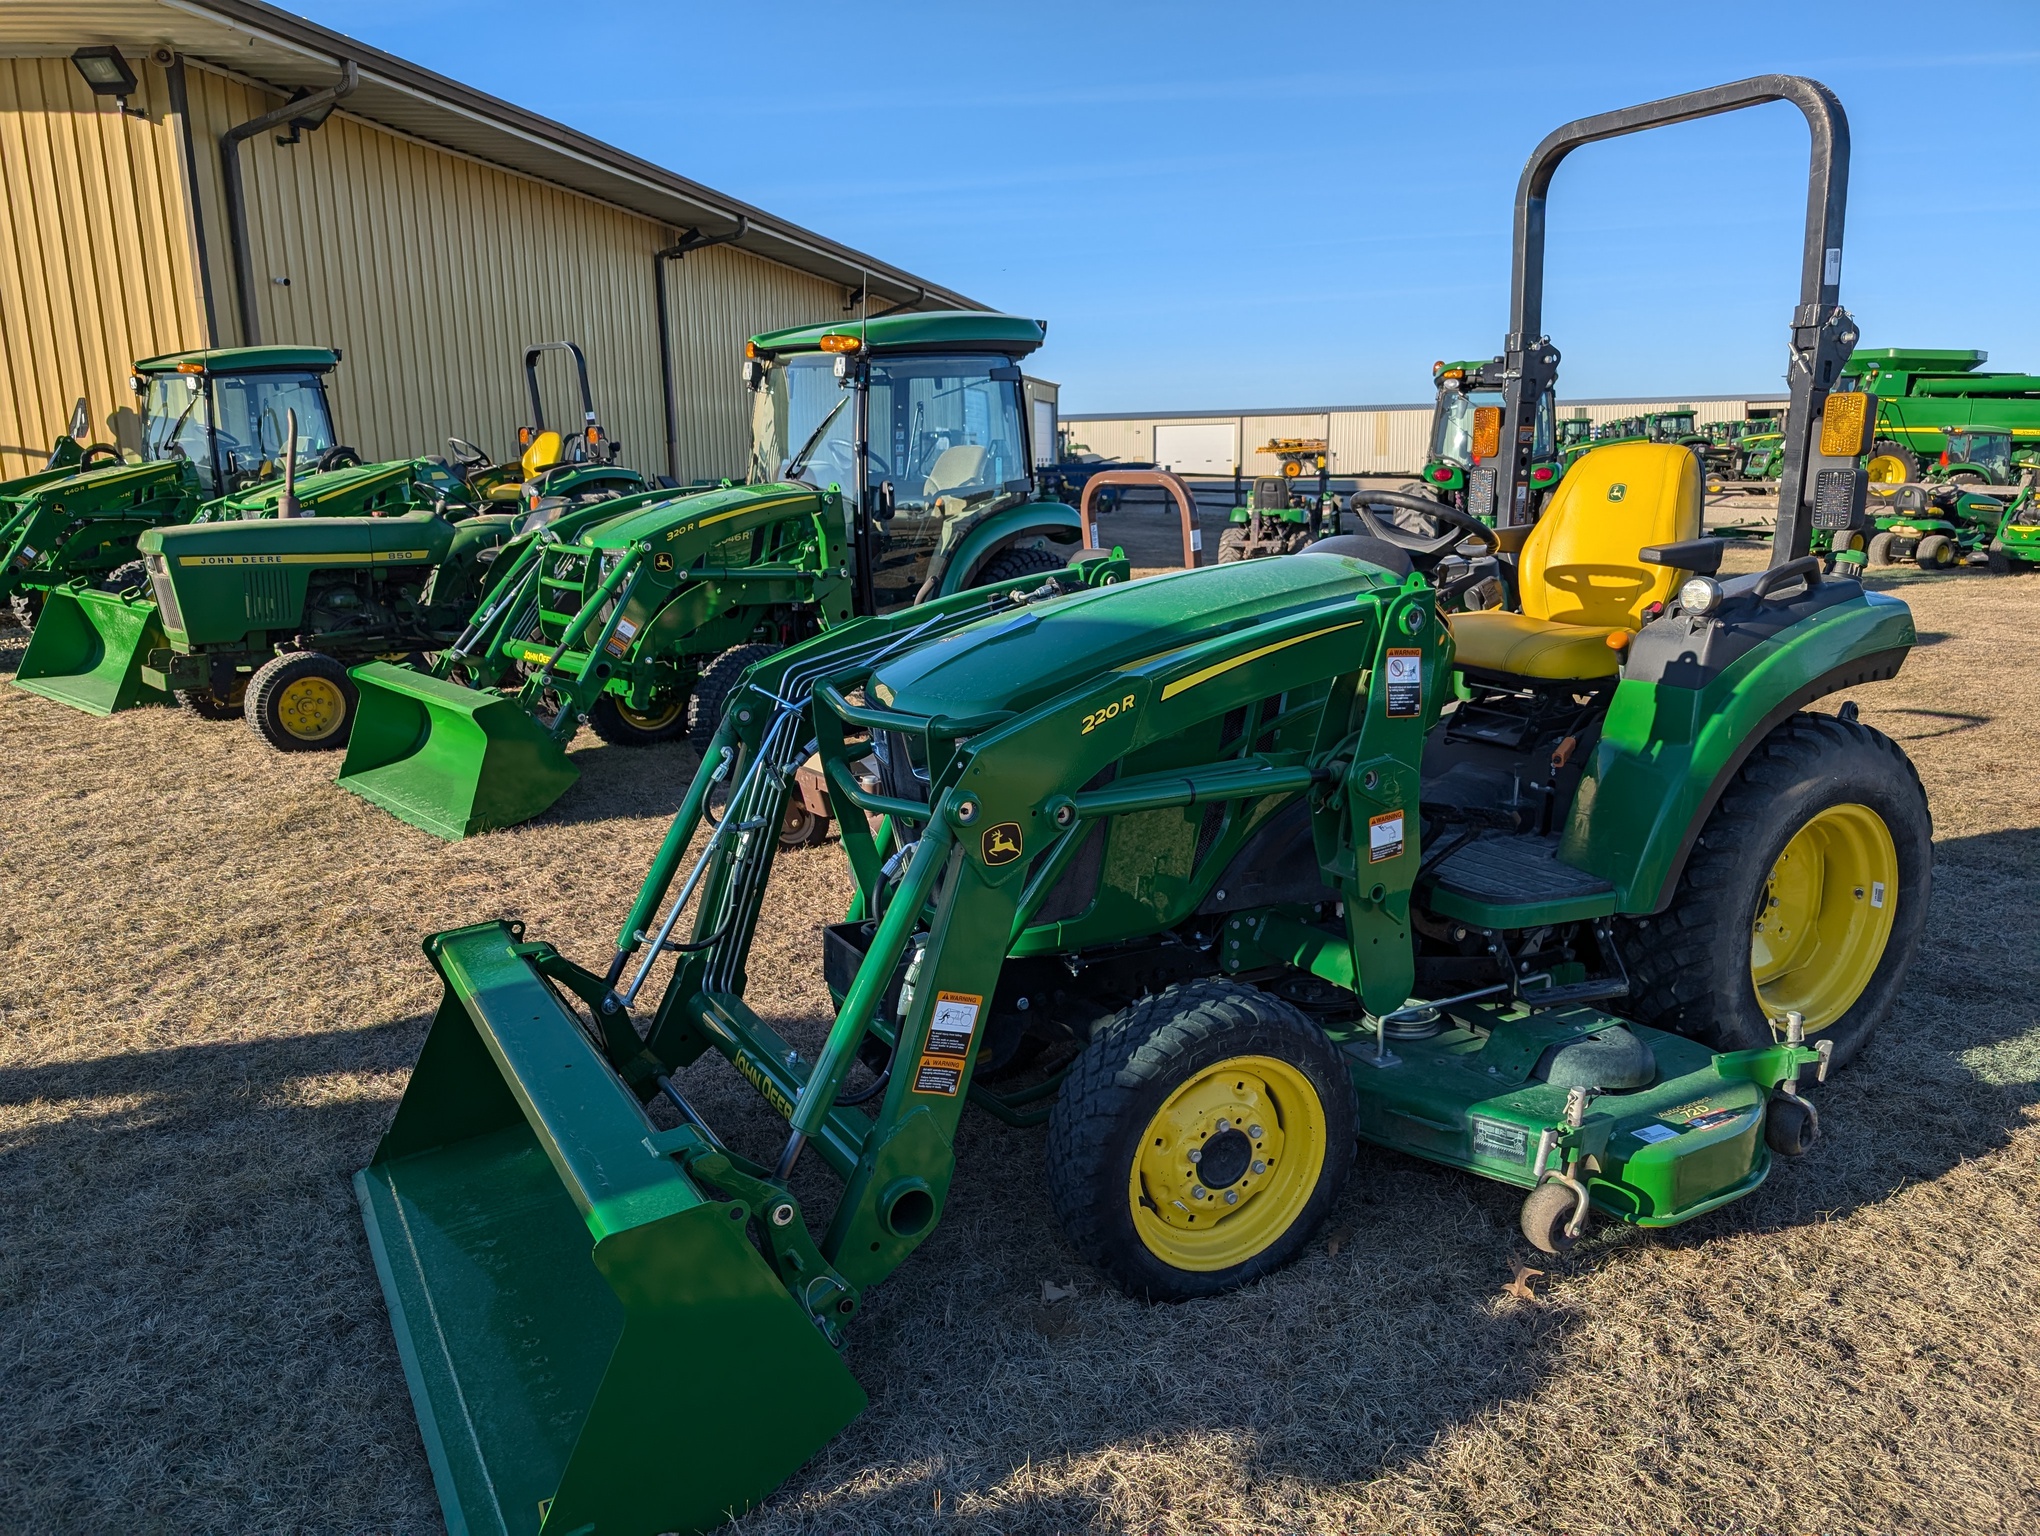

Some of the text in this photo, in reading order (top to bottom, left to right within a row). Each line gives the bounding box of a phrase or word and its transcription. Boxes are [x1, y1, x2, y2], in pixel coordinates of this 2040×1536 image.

[200, 552, 413, 565] JOHN DEERE 850
[1376, 811, 1402, 823] WARNING
[949, 994, 977, 1003] WARNING
[932, 1060, 960, 1068] WARNING
[732, 1048, 793, 1120] JOHN DEER
[1658, 1096, 1713, 1118] AutoConnect
[1679, 1105, 1710, 1118] 72D
